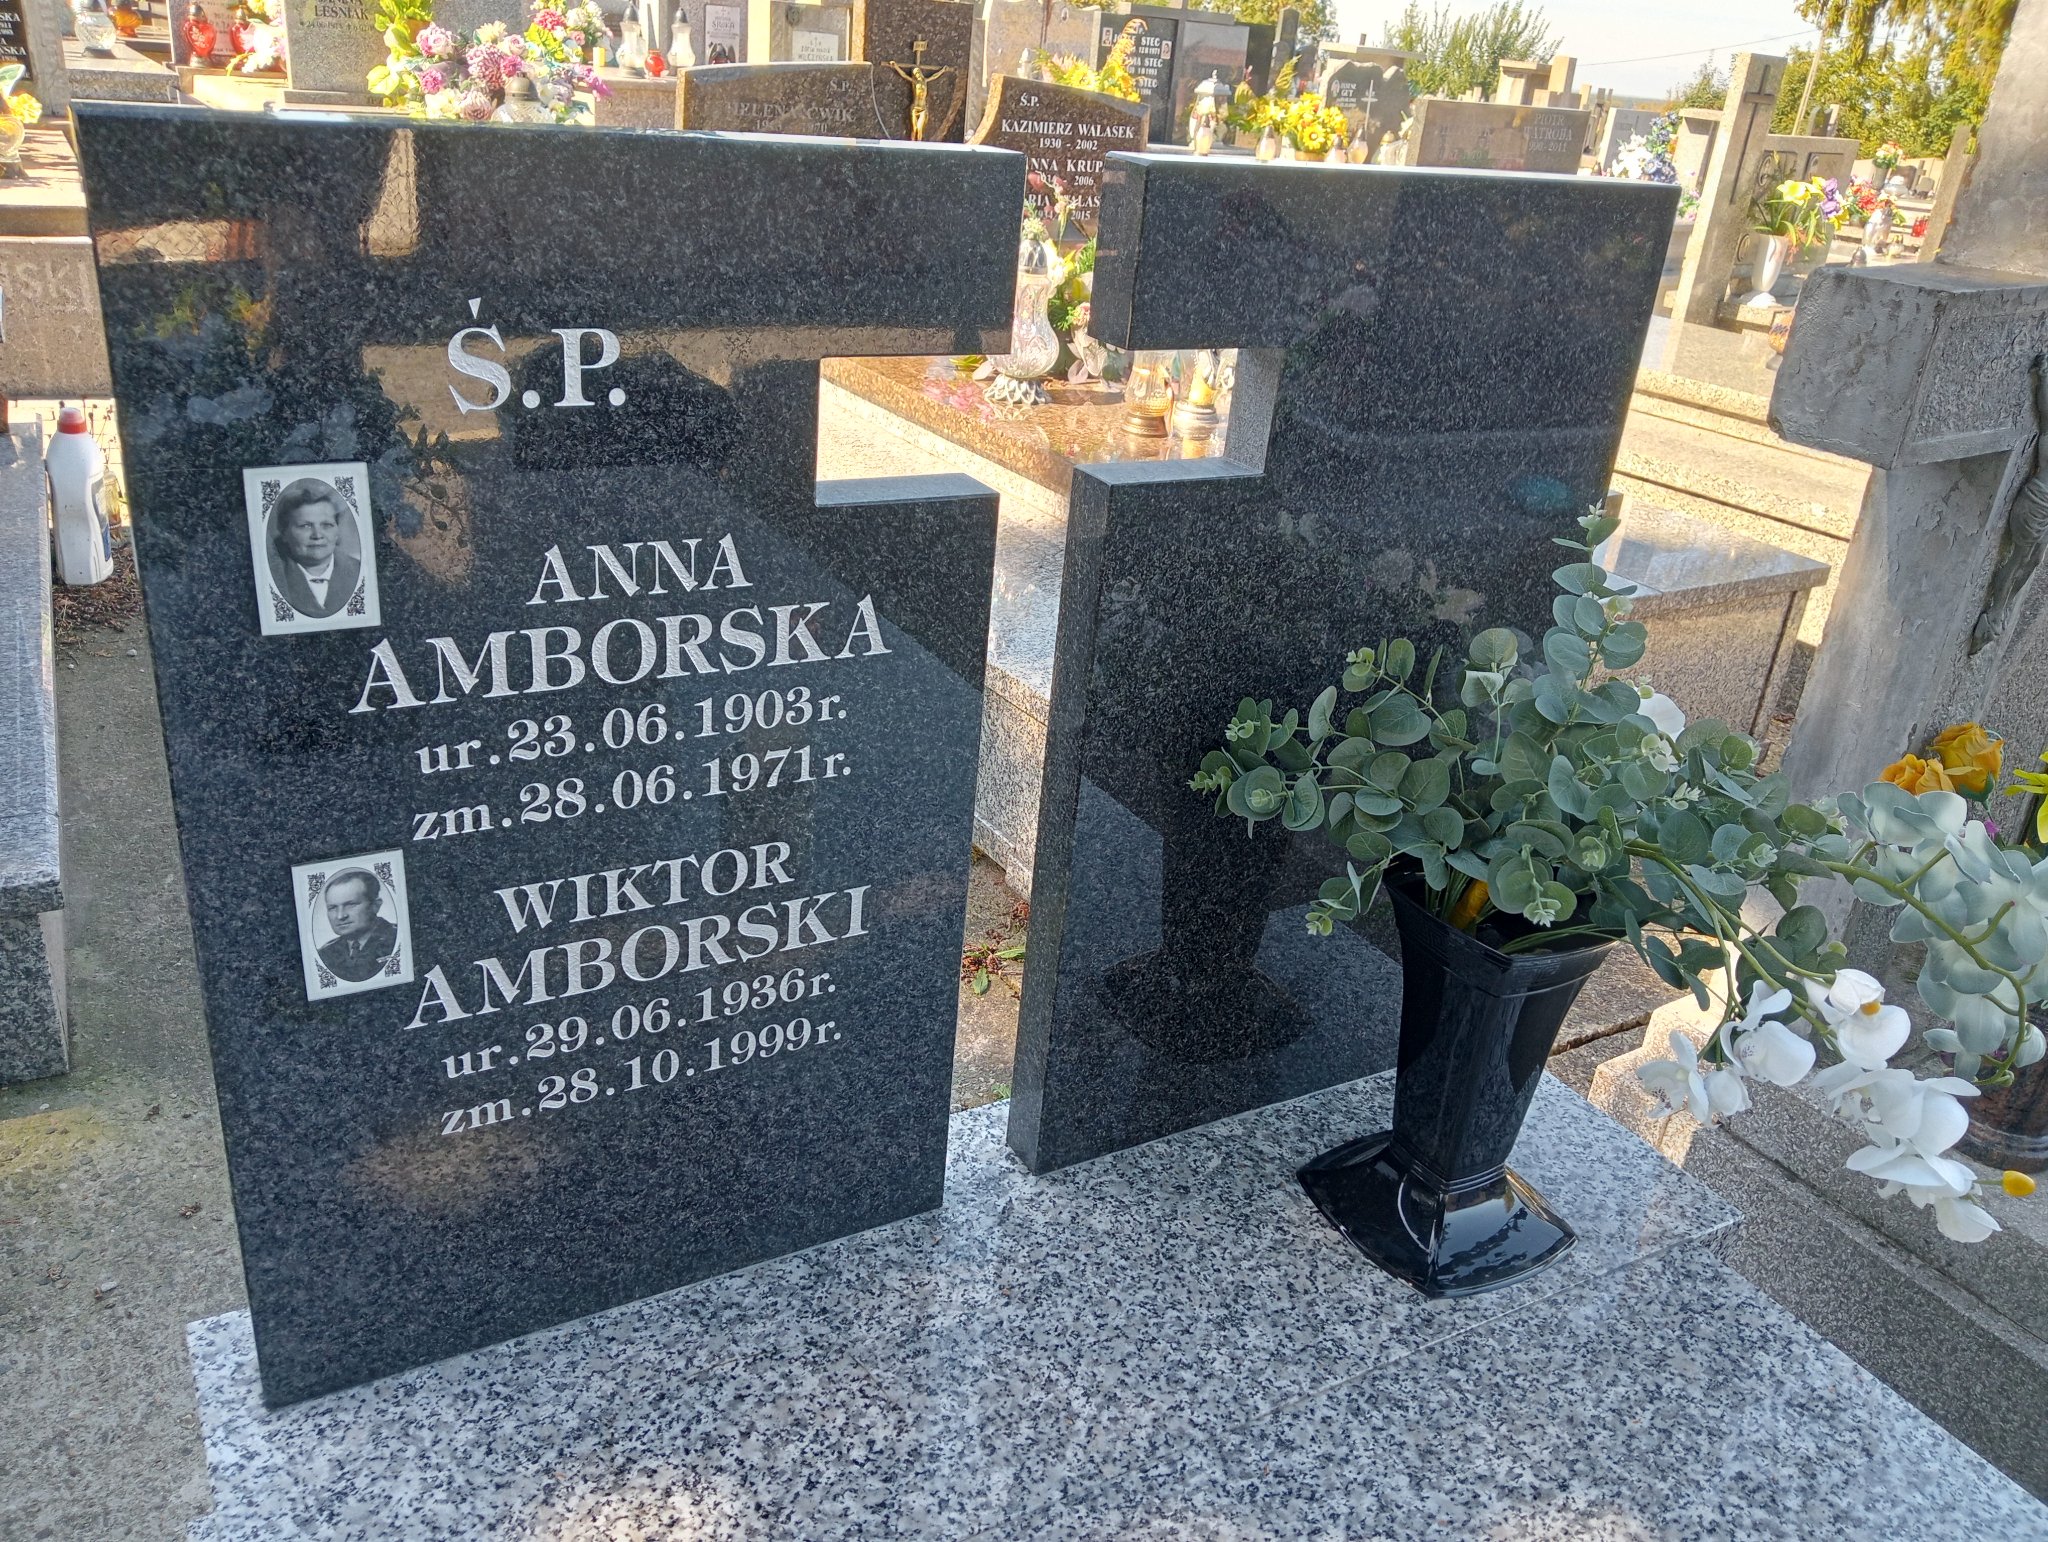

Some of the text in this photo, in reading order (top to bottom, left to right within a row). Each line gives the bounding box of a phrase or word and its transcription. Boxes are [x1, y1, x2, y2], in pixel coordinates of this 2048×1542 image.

[1141, 36, 1161, 47] STEC
[1144, 57, 1163, 68] STEC
[1020, 92, 1040, 107] Ś.P.
[1534, 113, 1566, 126] PIOTR
[1001, 119, 1136, 139] KAZIMIERZ WALASEK
[1039, 138, 1062, 149] 1930
[1075, 139, 1098, 151] 2002
[1026, 158, 1104, 173] NNA KRUP
[1073, 175, 1094, 186] 2006
[1028, 193, 1051, 207] RIA
[1070, 210, 1091, 221] 2015
[447, 297, 627, 415] Ś.P.
[525, 532, 754, 606] ANNA
[348, 593, 893, 714] AMBORSKA
[494, 840, 796, 934] WIKTOR
[403, 884, 872, 1031] AMBORSKI
